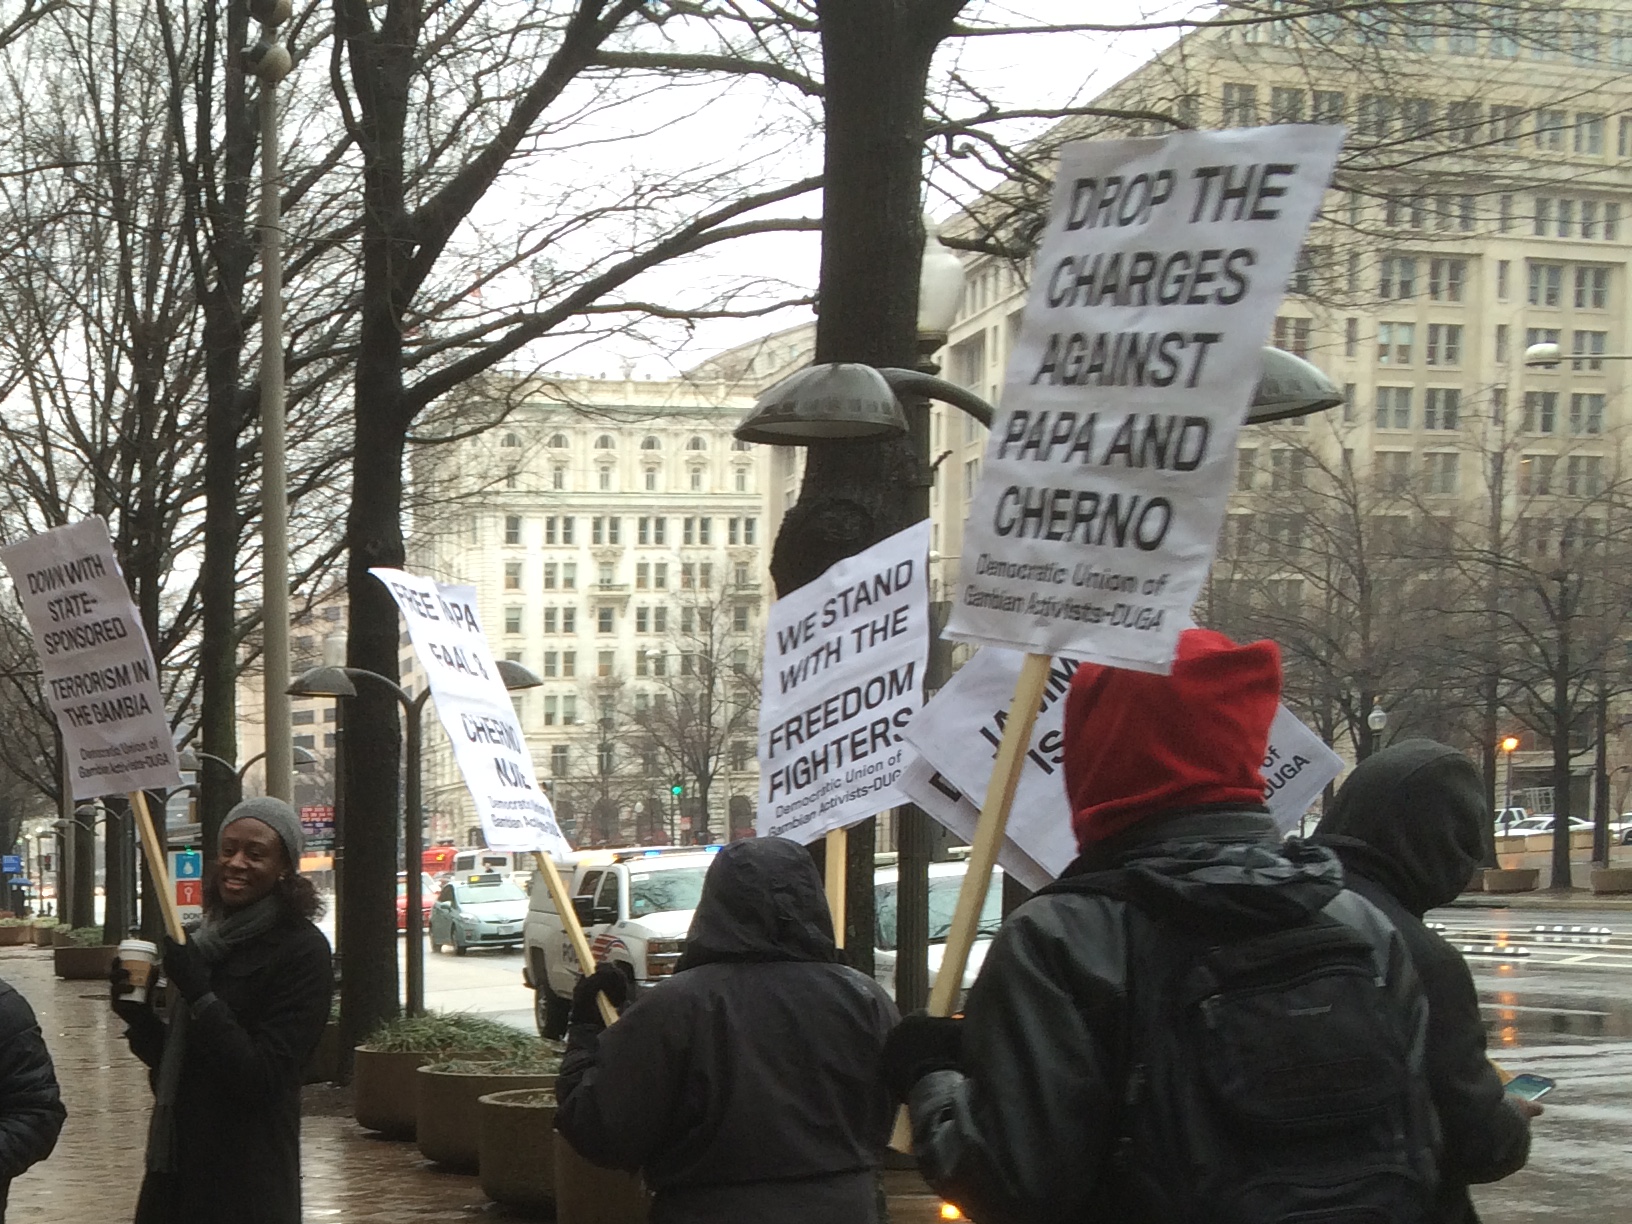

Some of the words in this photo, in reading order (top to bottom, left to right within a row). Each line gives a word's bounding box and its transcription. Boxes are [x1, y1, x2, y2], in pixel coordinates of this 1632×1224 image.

[1063, 168, 1178, 232] DROP
[1188, 163, 1299, 224] THE
[1046, 247, 1257, 309] CHARGES
[1030, 330, 1225, 389] AGAINST
[996, 409, 1097, 467] PAPA
[1103, 414, 1210, 473] AND
[993, 484, 1174, 551] CHERNO
[26, 562, 66, 595] DOWN
[63, 553, 107, 586] WITH
[390, 581, 440, 621] FREE
[976, 553, 1069, 585] Democratic
[1071, 562, 1138, 593] Union
[1141, 573, 1171, 597] of
[42, 616, 128, 655] SPONSORED
[46, 591, 98, 623] STATE-
[776, 611, 817, 656] WE
[820, 559, 914, 629] STAND
[49, 665, 130, 702] TERRORISM
[129, 657, 151, 684] IN
[778, 635, 842, 694] WITH
[850, 604, 910, 654] THE
[64, 703, 93, 729] THE
[92, 692, 153, 725] GAMBIA
[768, 660, 917, 759] FREEDOM
[768, 705, 914, 803] FIGHTERS
[775, 777, 843, 819] Democratic
[845, 760, 884, 784] Union
[887, 749, 903, 767] of
